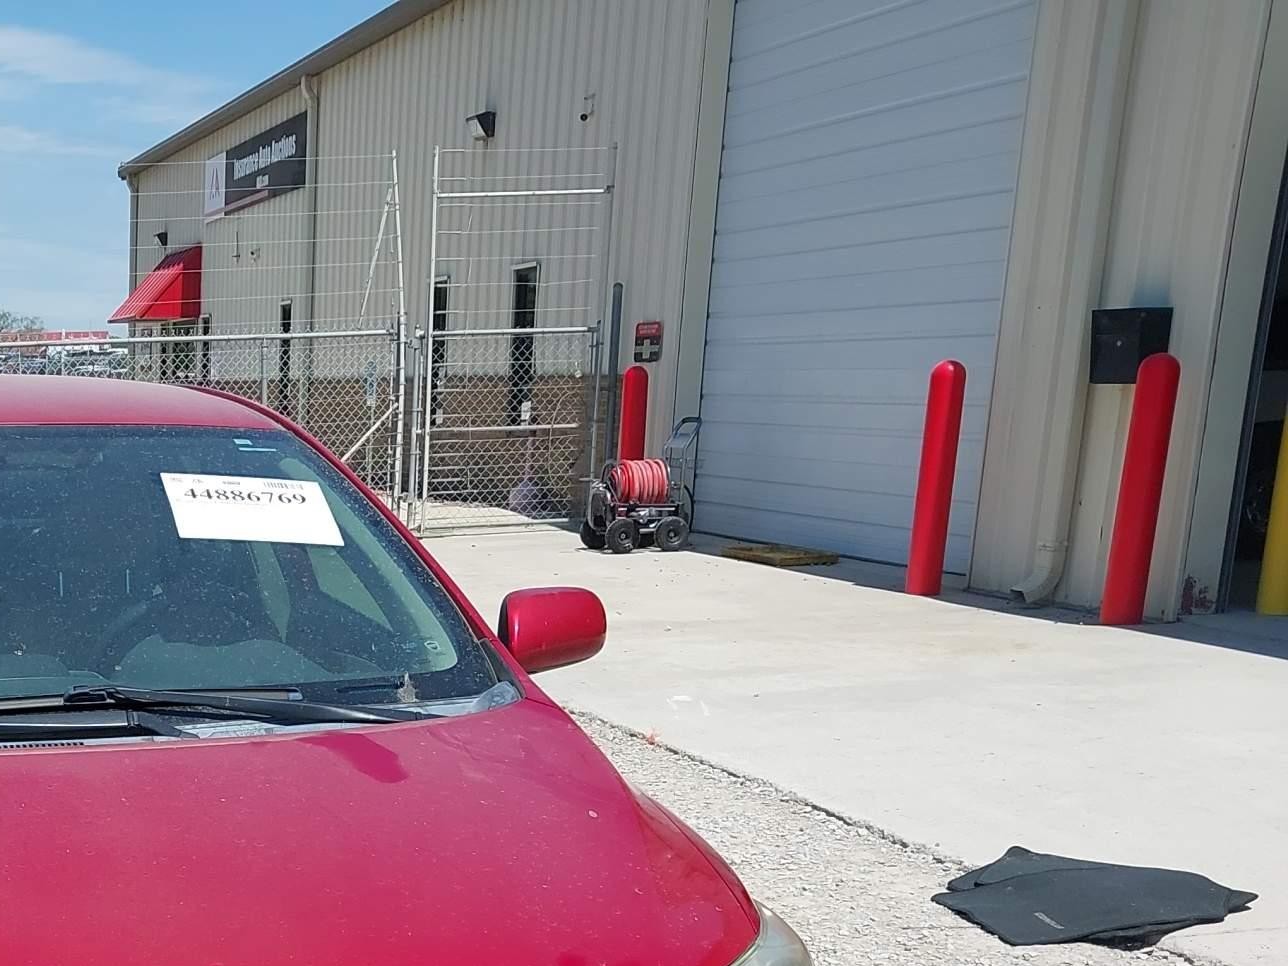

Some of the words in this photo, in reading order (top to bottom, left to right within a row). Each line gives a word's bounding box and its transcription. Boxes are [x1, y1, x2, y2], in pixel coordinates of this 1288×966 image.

[234, 152, 258, 181] Insurance
[259, 145, 271, 169] Auto
[271, 134, 296, 164] Auctions
[184, 487, 307, 504] 44886769
